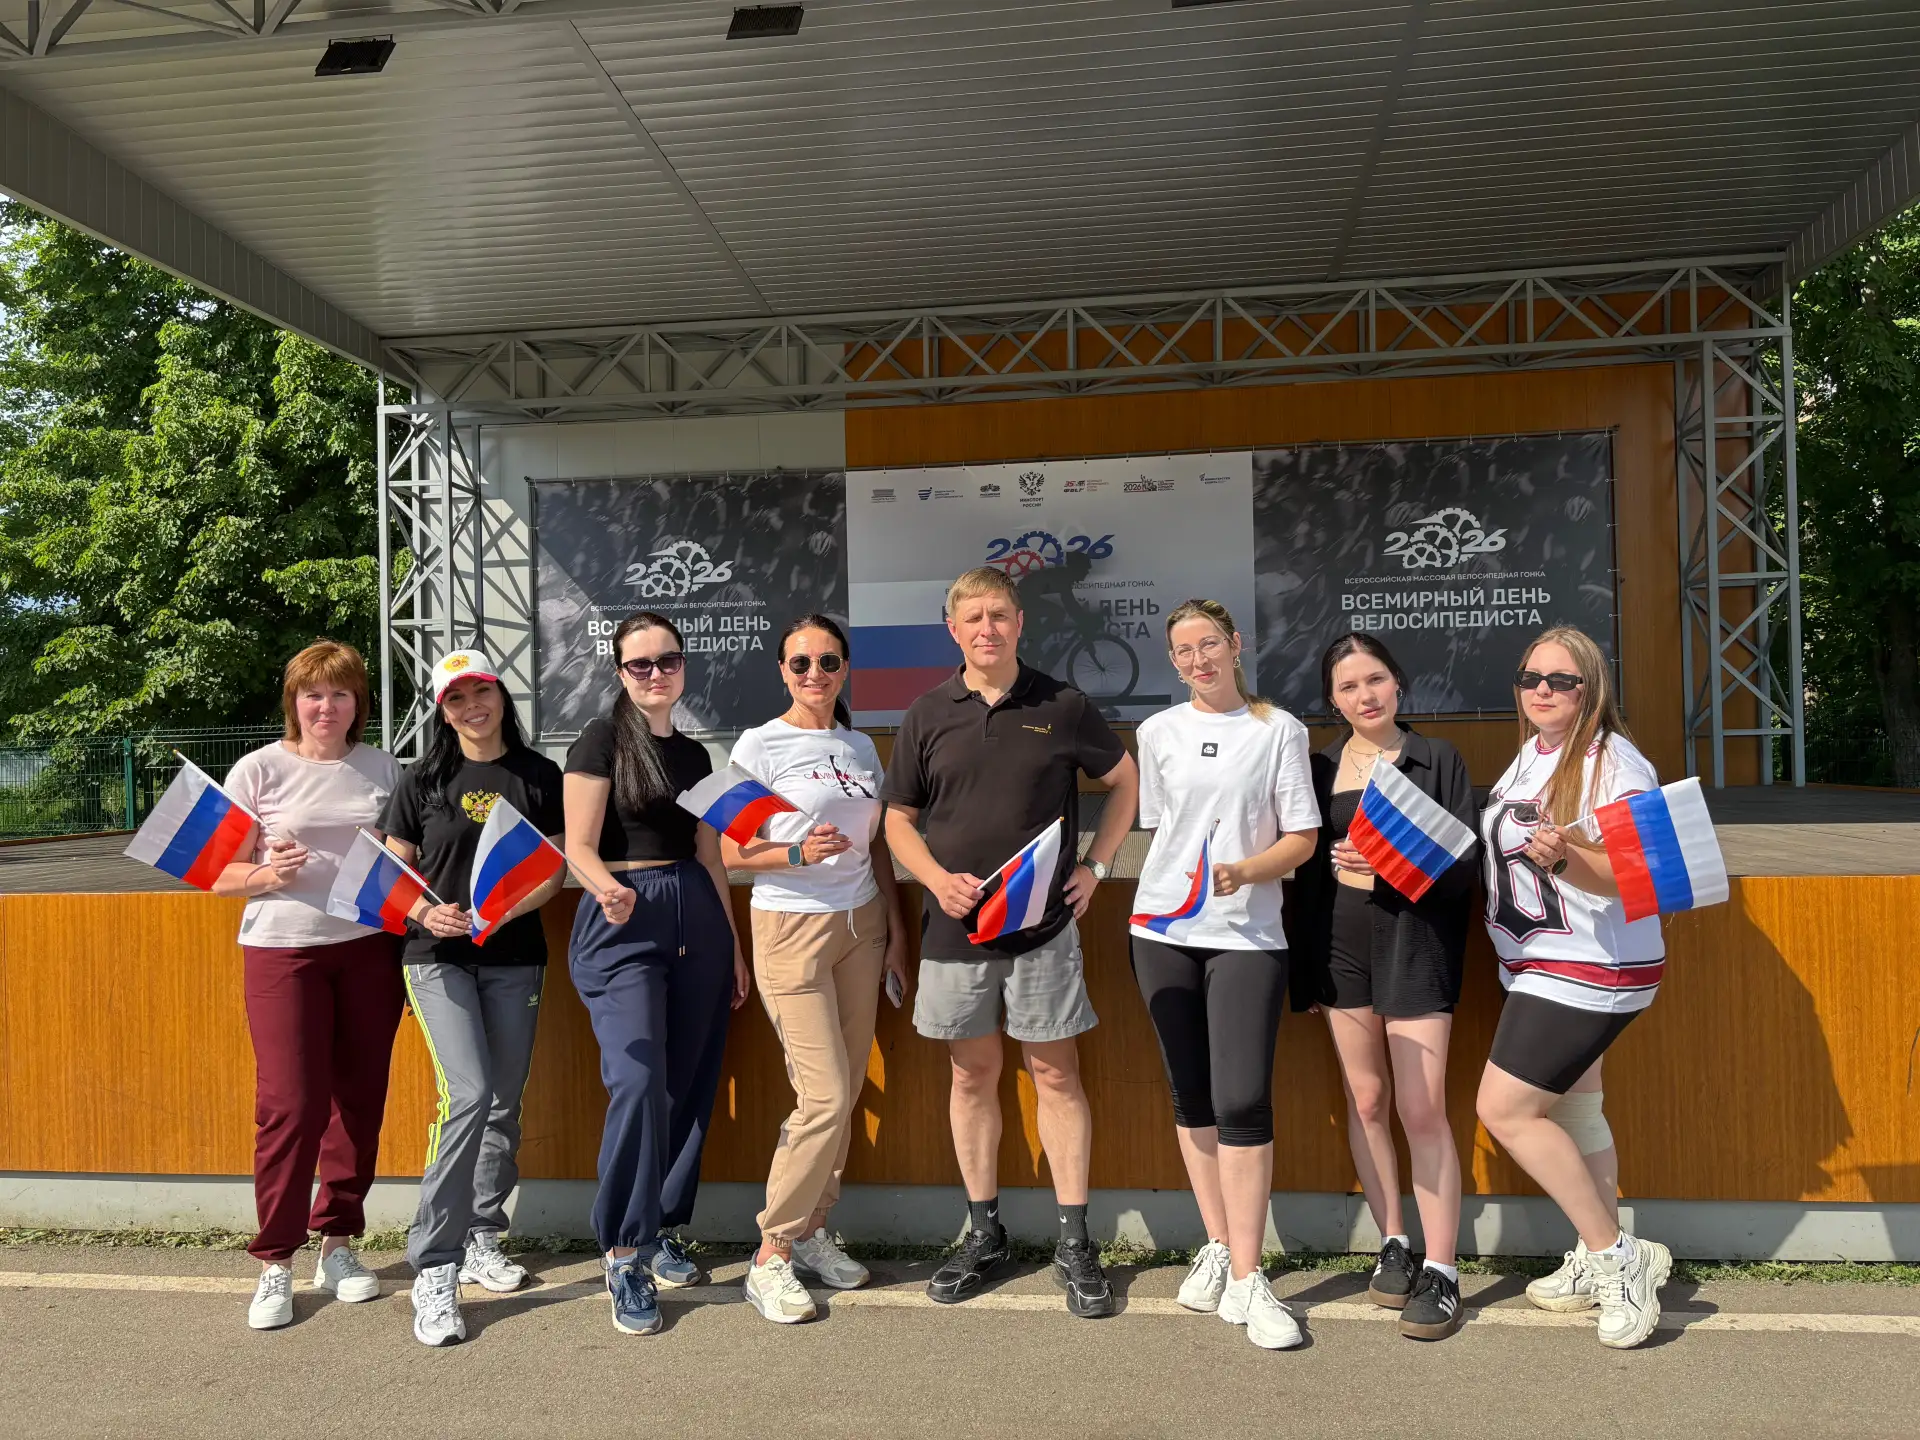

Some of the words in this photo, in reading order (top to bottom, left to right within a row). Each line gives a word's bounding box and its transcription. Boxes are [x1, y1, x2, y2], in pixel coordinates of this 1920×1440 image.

[1128, 580, 1155, 588] ГОНКА
[1344, 575, 1412, 585] ВСЕРОССИЙСКАЯ
[1413, 573, 1456, 582] МАССОВАЯ
[1457, 571, 1519, 580] ВЕЛОСИПЕДНАЯ
[1520, 570, 1546, 578] ГОНКА
[590, 603, 649, 612] ВСЕРОССИЙСКАЯ
[650, 602, 688, 610] МАССОВАЯ
[689, 601, 743, 609] ВЕЛОСИПЕДНАЯ
[1100, 598, 1160, 617] ДЕНЬ
[1341, 587, 1484, 611] ВСЕМИРНЫЙ
[1491, 587, 1551, 605] ДЕНЬ
[718, 615, 771, 633] ДЕНЬ
[1350, 608, 1543, 631] ВЕЛОСИПЕДИСТА
